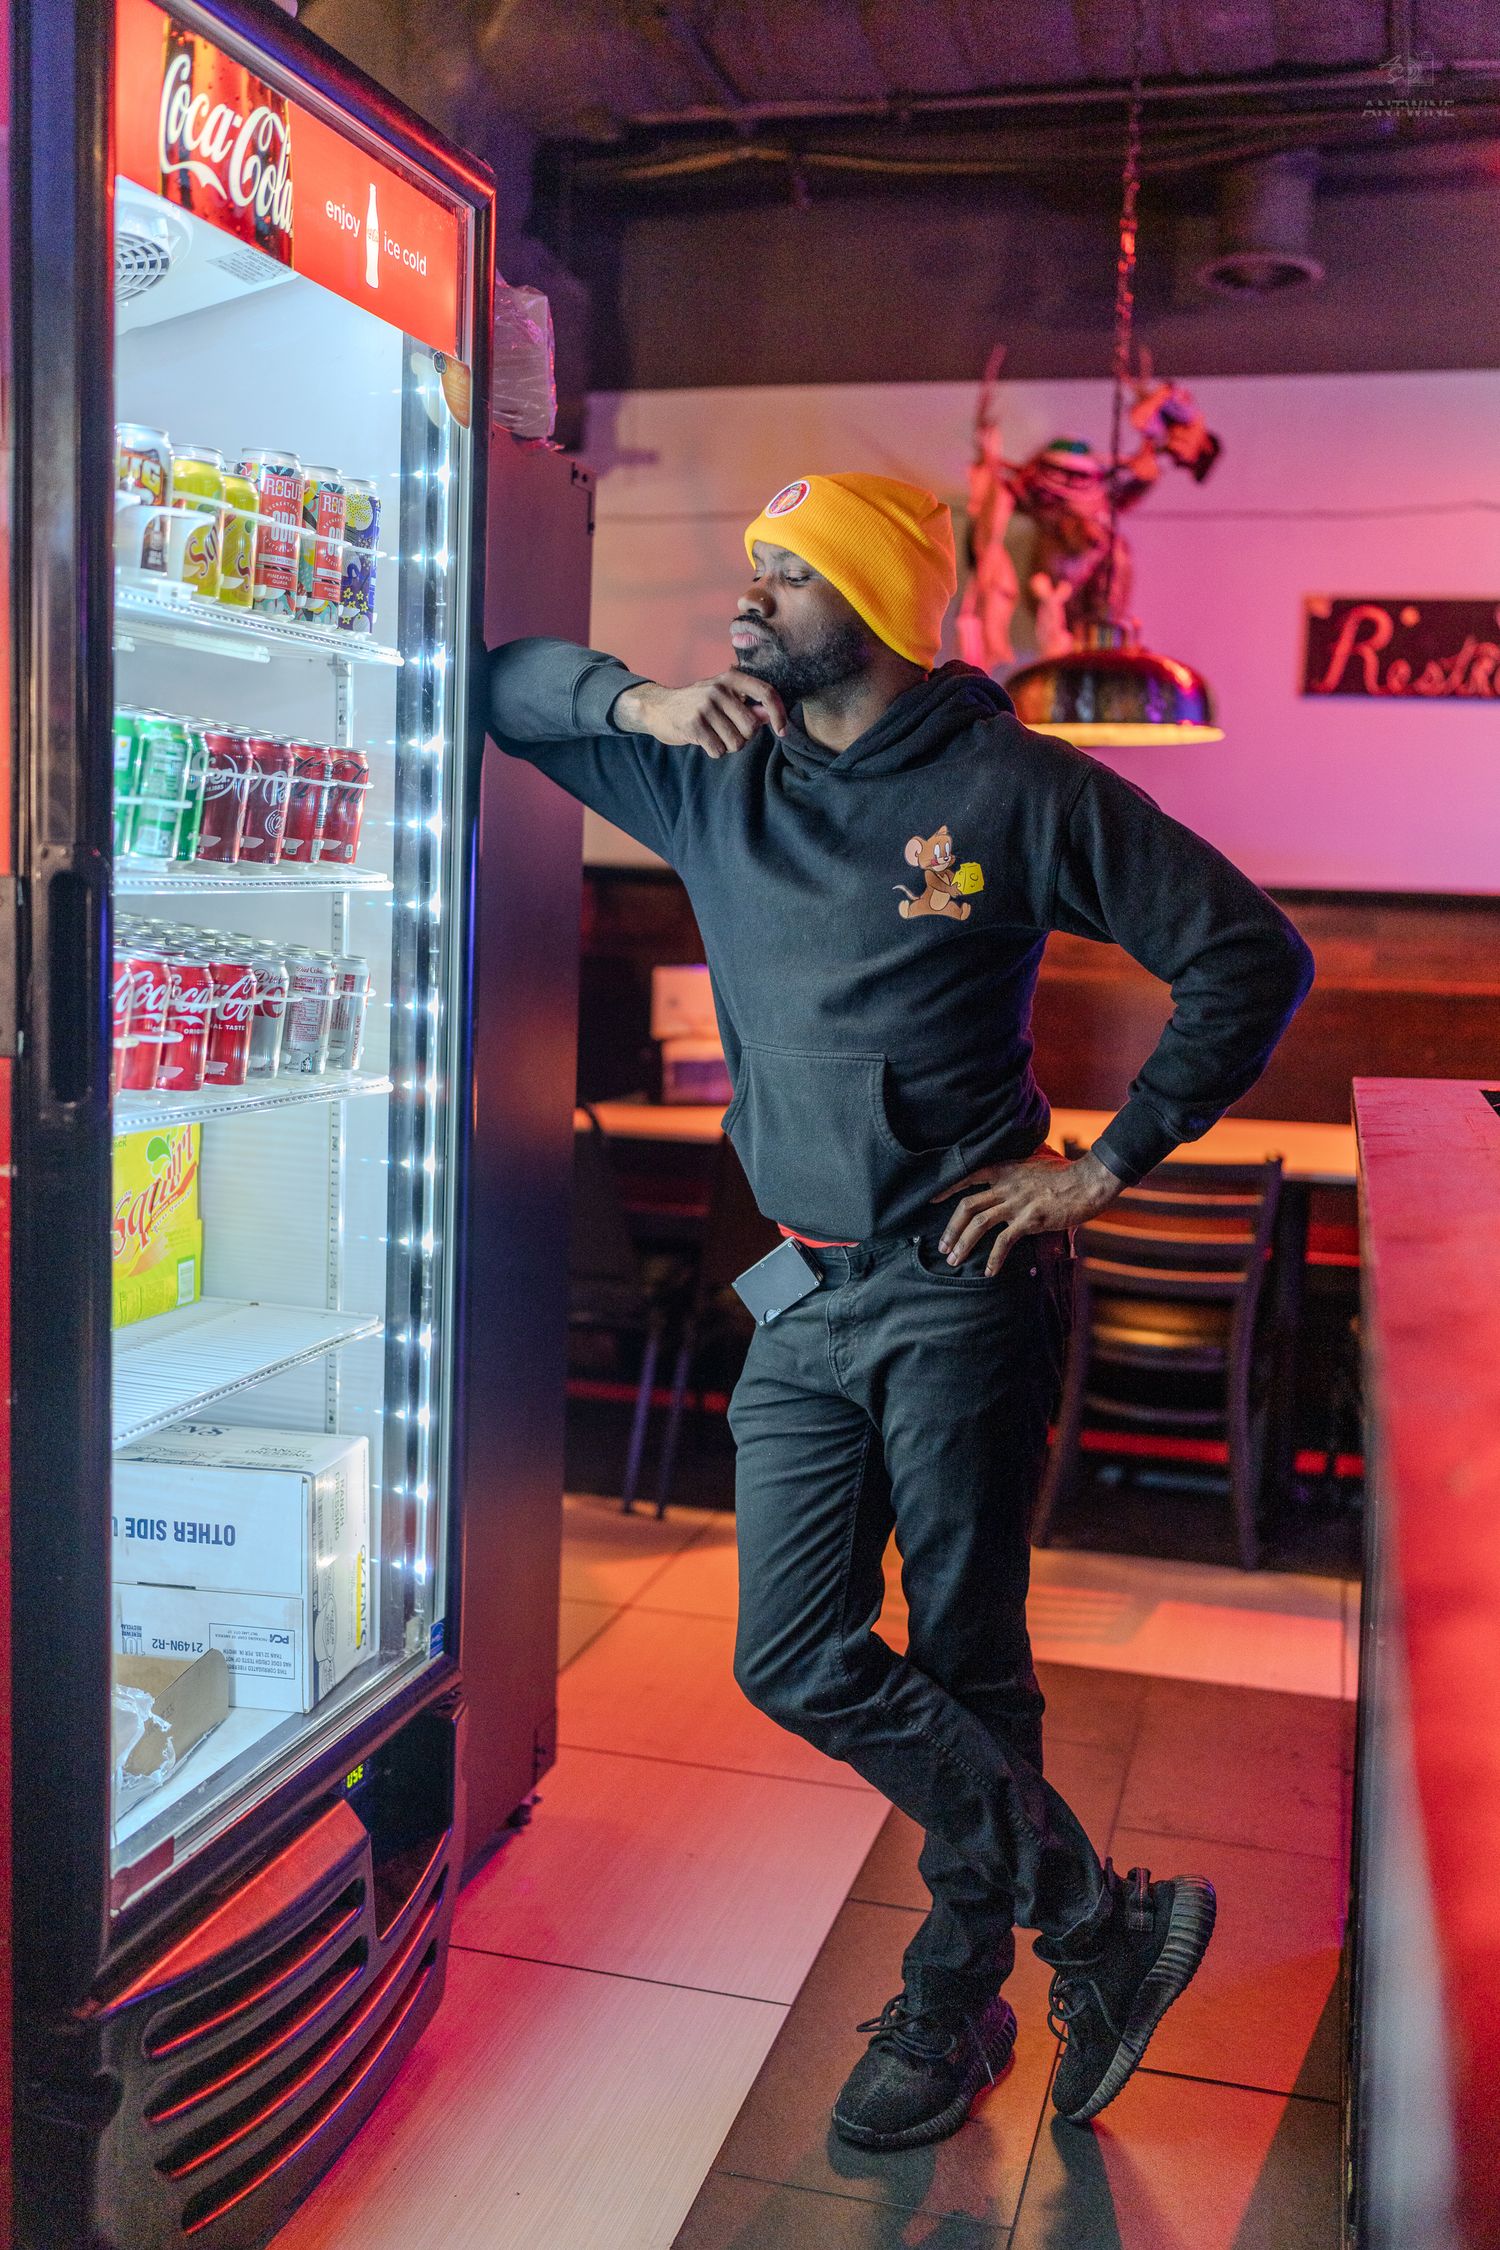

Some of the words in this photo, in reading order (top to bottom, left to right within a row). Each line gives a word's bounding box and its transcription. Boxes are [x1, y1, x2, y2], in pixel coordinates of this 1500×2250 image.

[158, 53, 294, 235] Coca-Cola
[325, 200, 360, 237] enjoy
[383, 231, 401, 260] ice
[402, 251, 427, 276] cold
[322, 494, 346, 514] ROG
[125, 1517, 167, 1541] SIDE
[173, 1520, 236, 1546] OTHER
[151, 1638, 204, 1653] 2149N-R2
